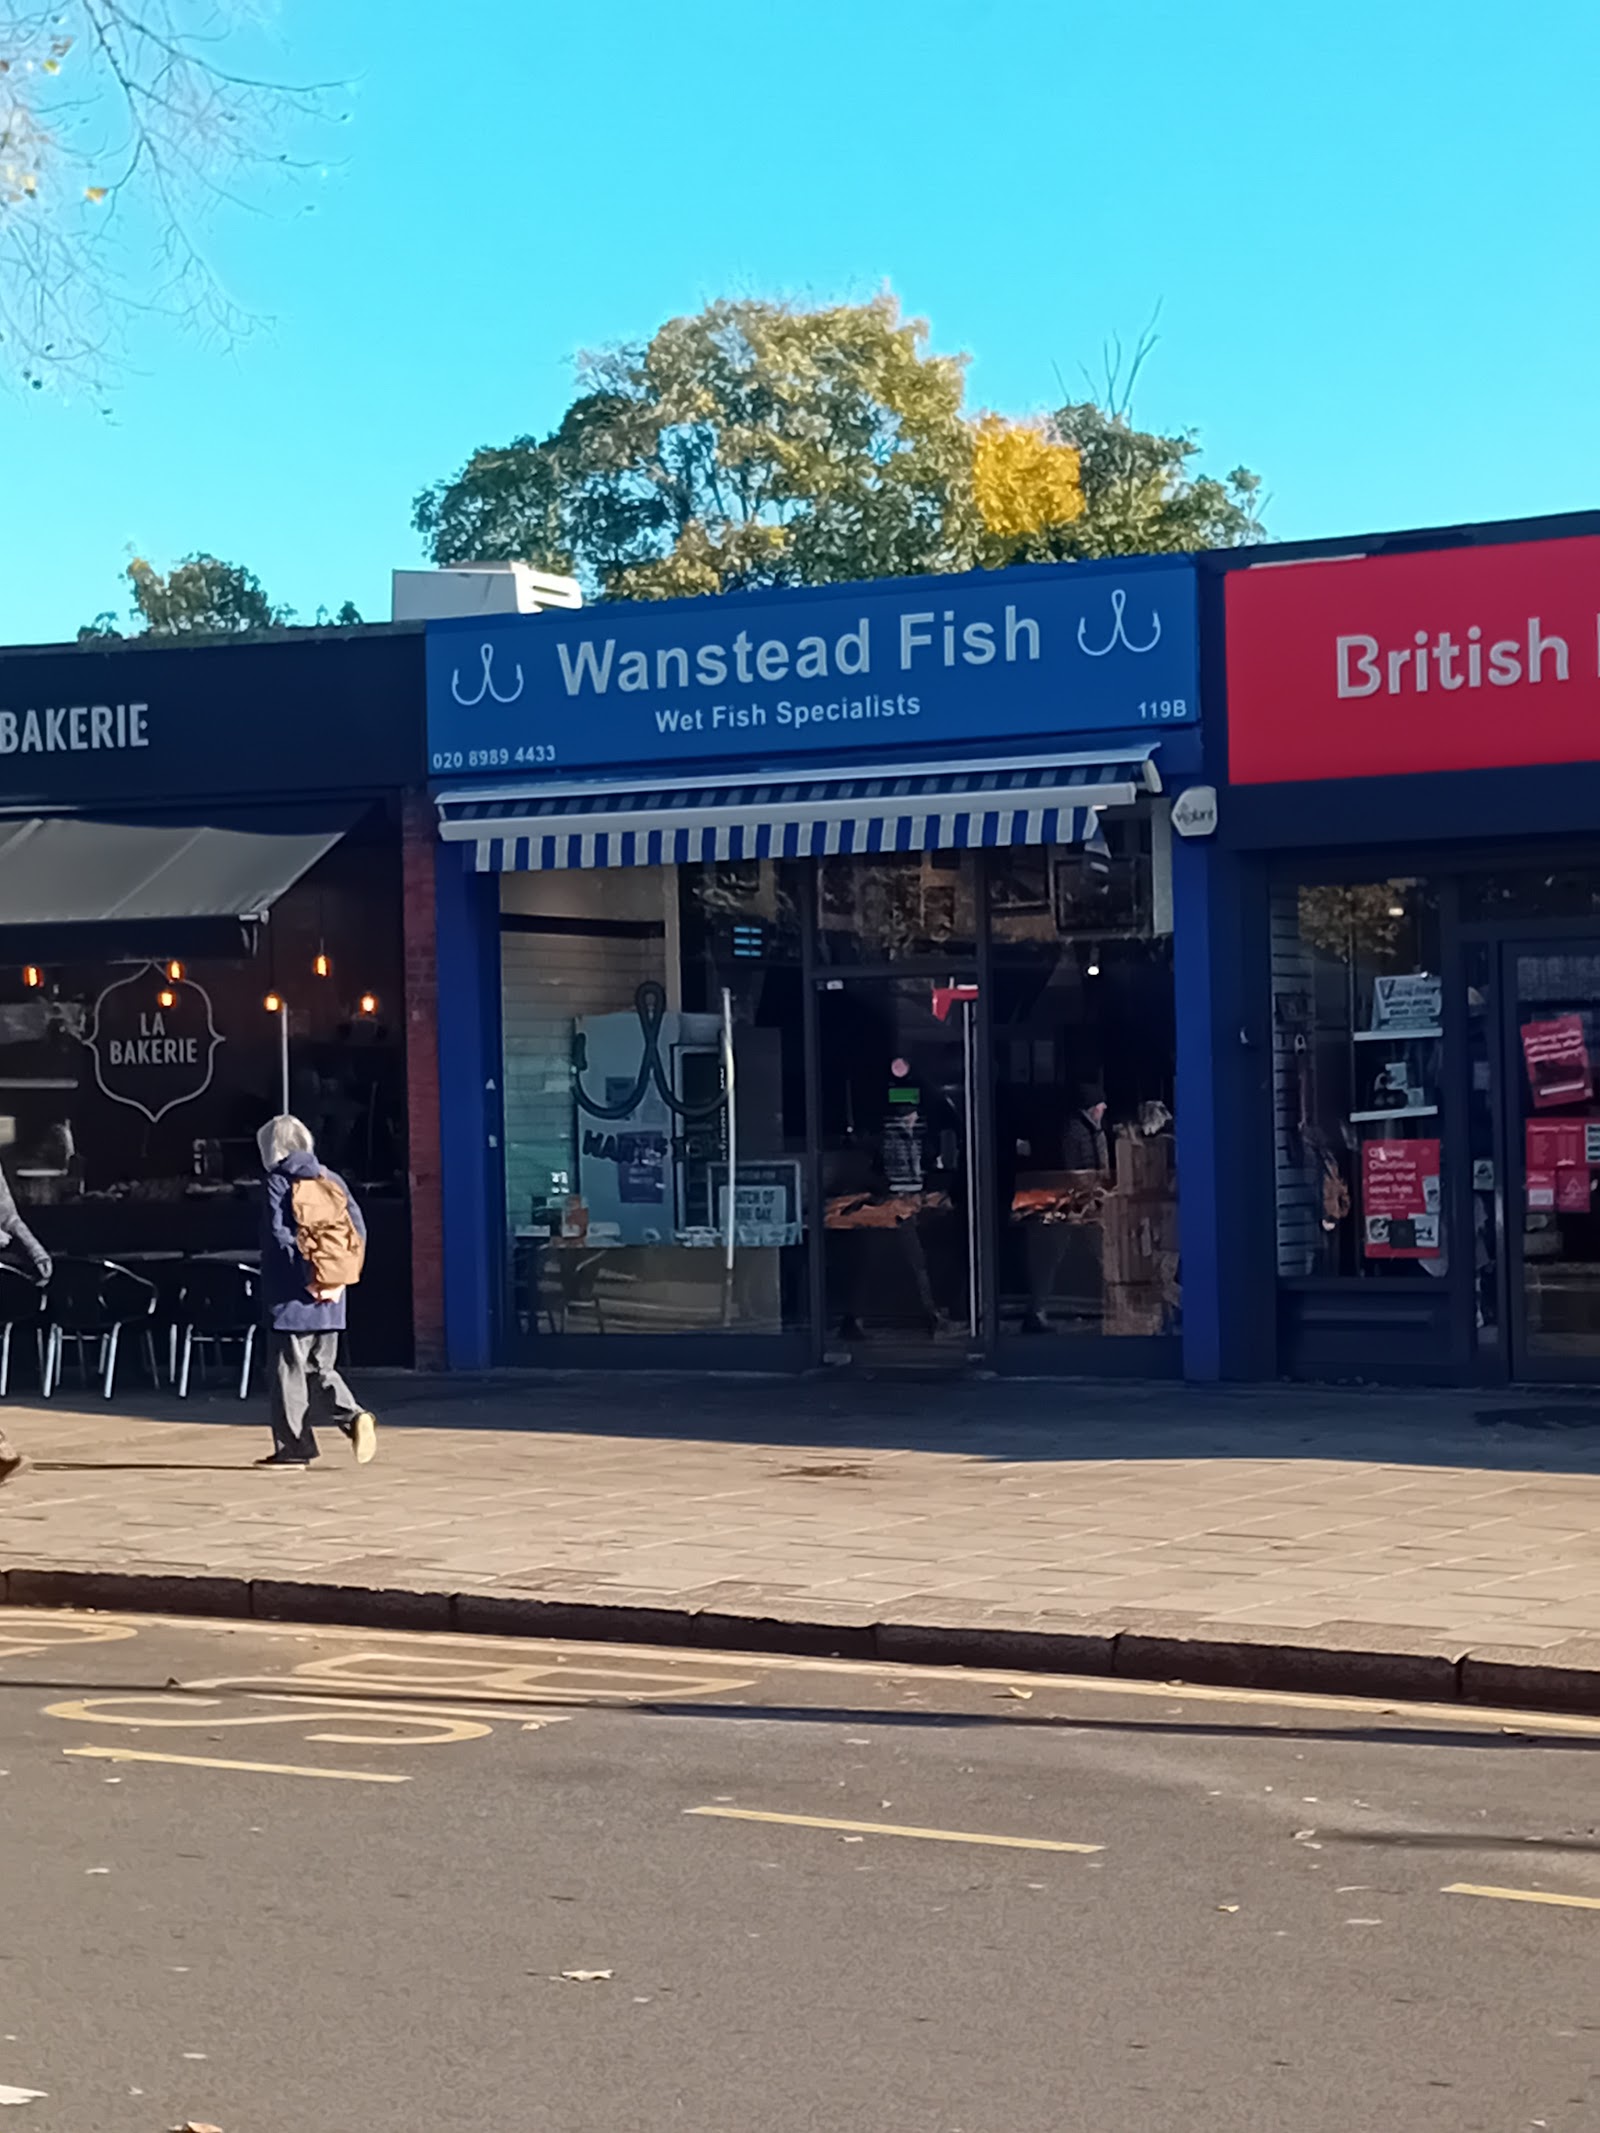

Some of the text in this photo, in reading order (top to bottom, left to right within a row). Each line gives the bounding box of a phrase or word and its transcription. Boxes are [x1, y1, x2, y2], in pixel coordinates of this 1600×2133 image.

[556, 604, 1041, 696] Wanstead Fish
[1336, 617, 1569, 699] British
[655, 694, 922, 733] Wet Fish Specialists
[1138, 699, 1187, 718] 119B
[0, 704, 149, 754] BAKERIE
[432, 744, 556, 769] 020 8989 4433
[140, 1012, 166, 1036] LA
[109, 1038, 198, 1065] BAKERIE
